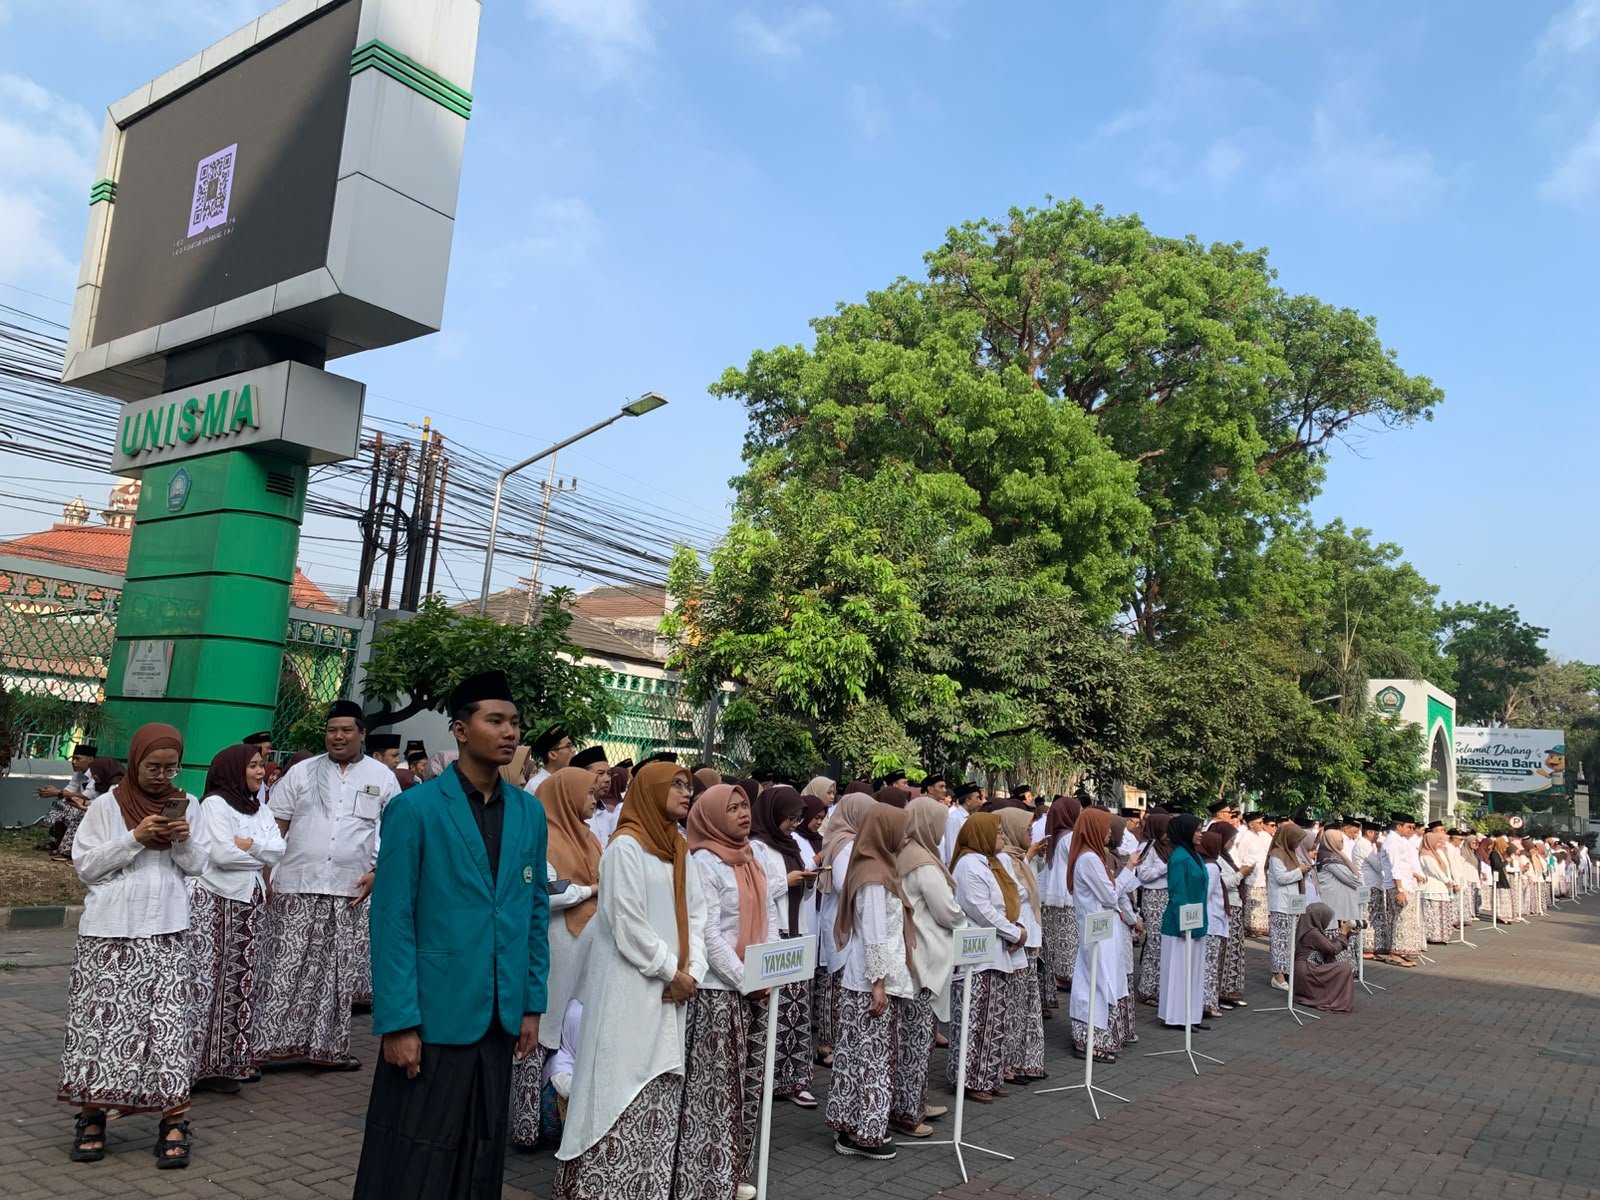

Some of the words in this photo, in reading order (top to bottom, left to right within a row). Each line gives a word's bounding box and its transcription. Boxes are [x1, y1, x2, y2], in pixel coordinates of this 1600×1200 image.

[121, 384, 259, 456] UNISMA
[1456, 741, 1491, 754] Selamat
[1493, 744, 1533, 760] Datang
[1456, 755, 1509, 767] ahasiswa
[1511, 758, 1542, 768] Baru
[1513, 817, 1521, 825] P
[962, 937, 987, 954] BAKAK
[764, 949, 804, 974] YAYASAN
